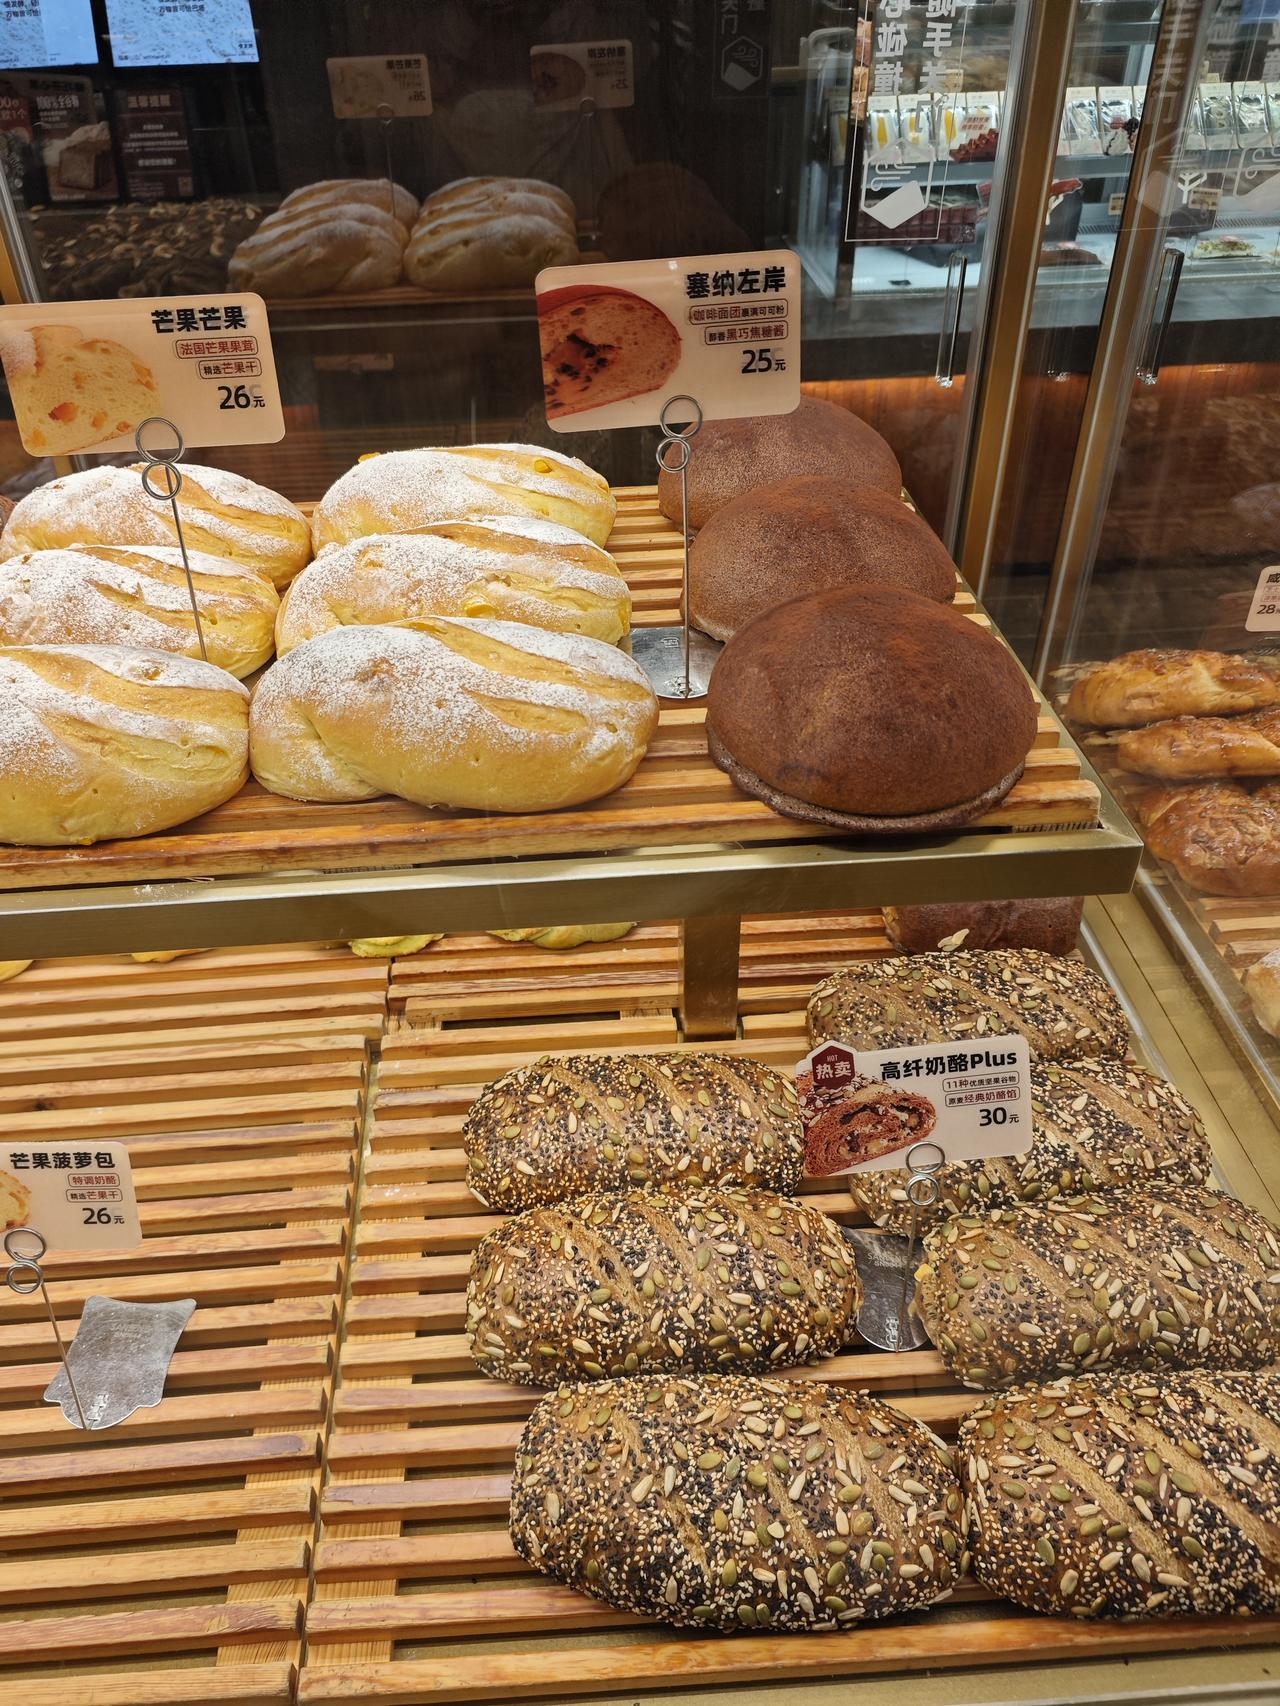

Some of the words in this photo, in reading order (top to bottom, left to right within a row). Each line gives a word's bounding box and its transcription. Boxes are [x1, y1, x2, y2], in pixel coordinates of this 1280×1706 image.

[685, 265, 787, 300] 塞纳左岸
[151, 305, 248, 334] 芒果芒果
[179, 339, 256, 356] 法国芒果果茸
[203, 360, 258, 376] 精选芒果干
[741, 348, 786, 374] 25元
[217, 384, 266, 410] 26元
[827, 1053, 838, 1062] HOT
[880, 1050, 1018, 1082] 高纤奶酪Plus
[815, 1060, 852, 1080] 热卖
[946, 1075, 1017, 1089] 11种优质坚果谷物
[978, 1106, 1020, 1127] 30元
[9, 1151, 116, 1170] 芒果菠萝包
[72, 1175, 118, 1186] 特调奶酪
[70, 1190, 119, 1200] 精选芒果干
[81, 1207, 125, 1225] 26元
